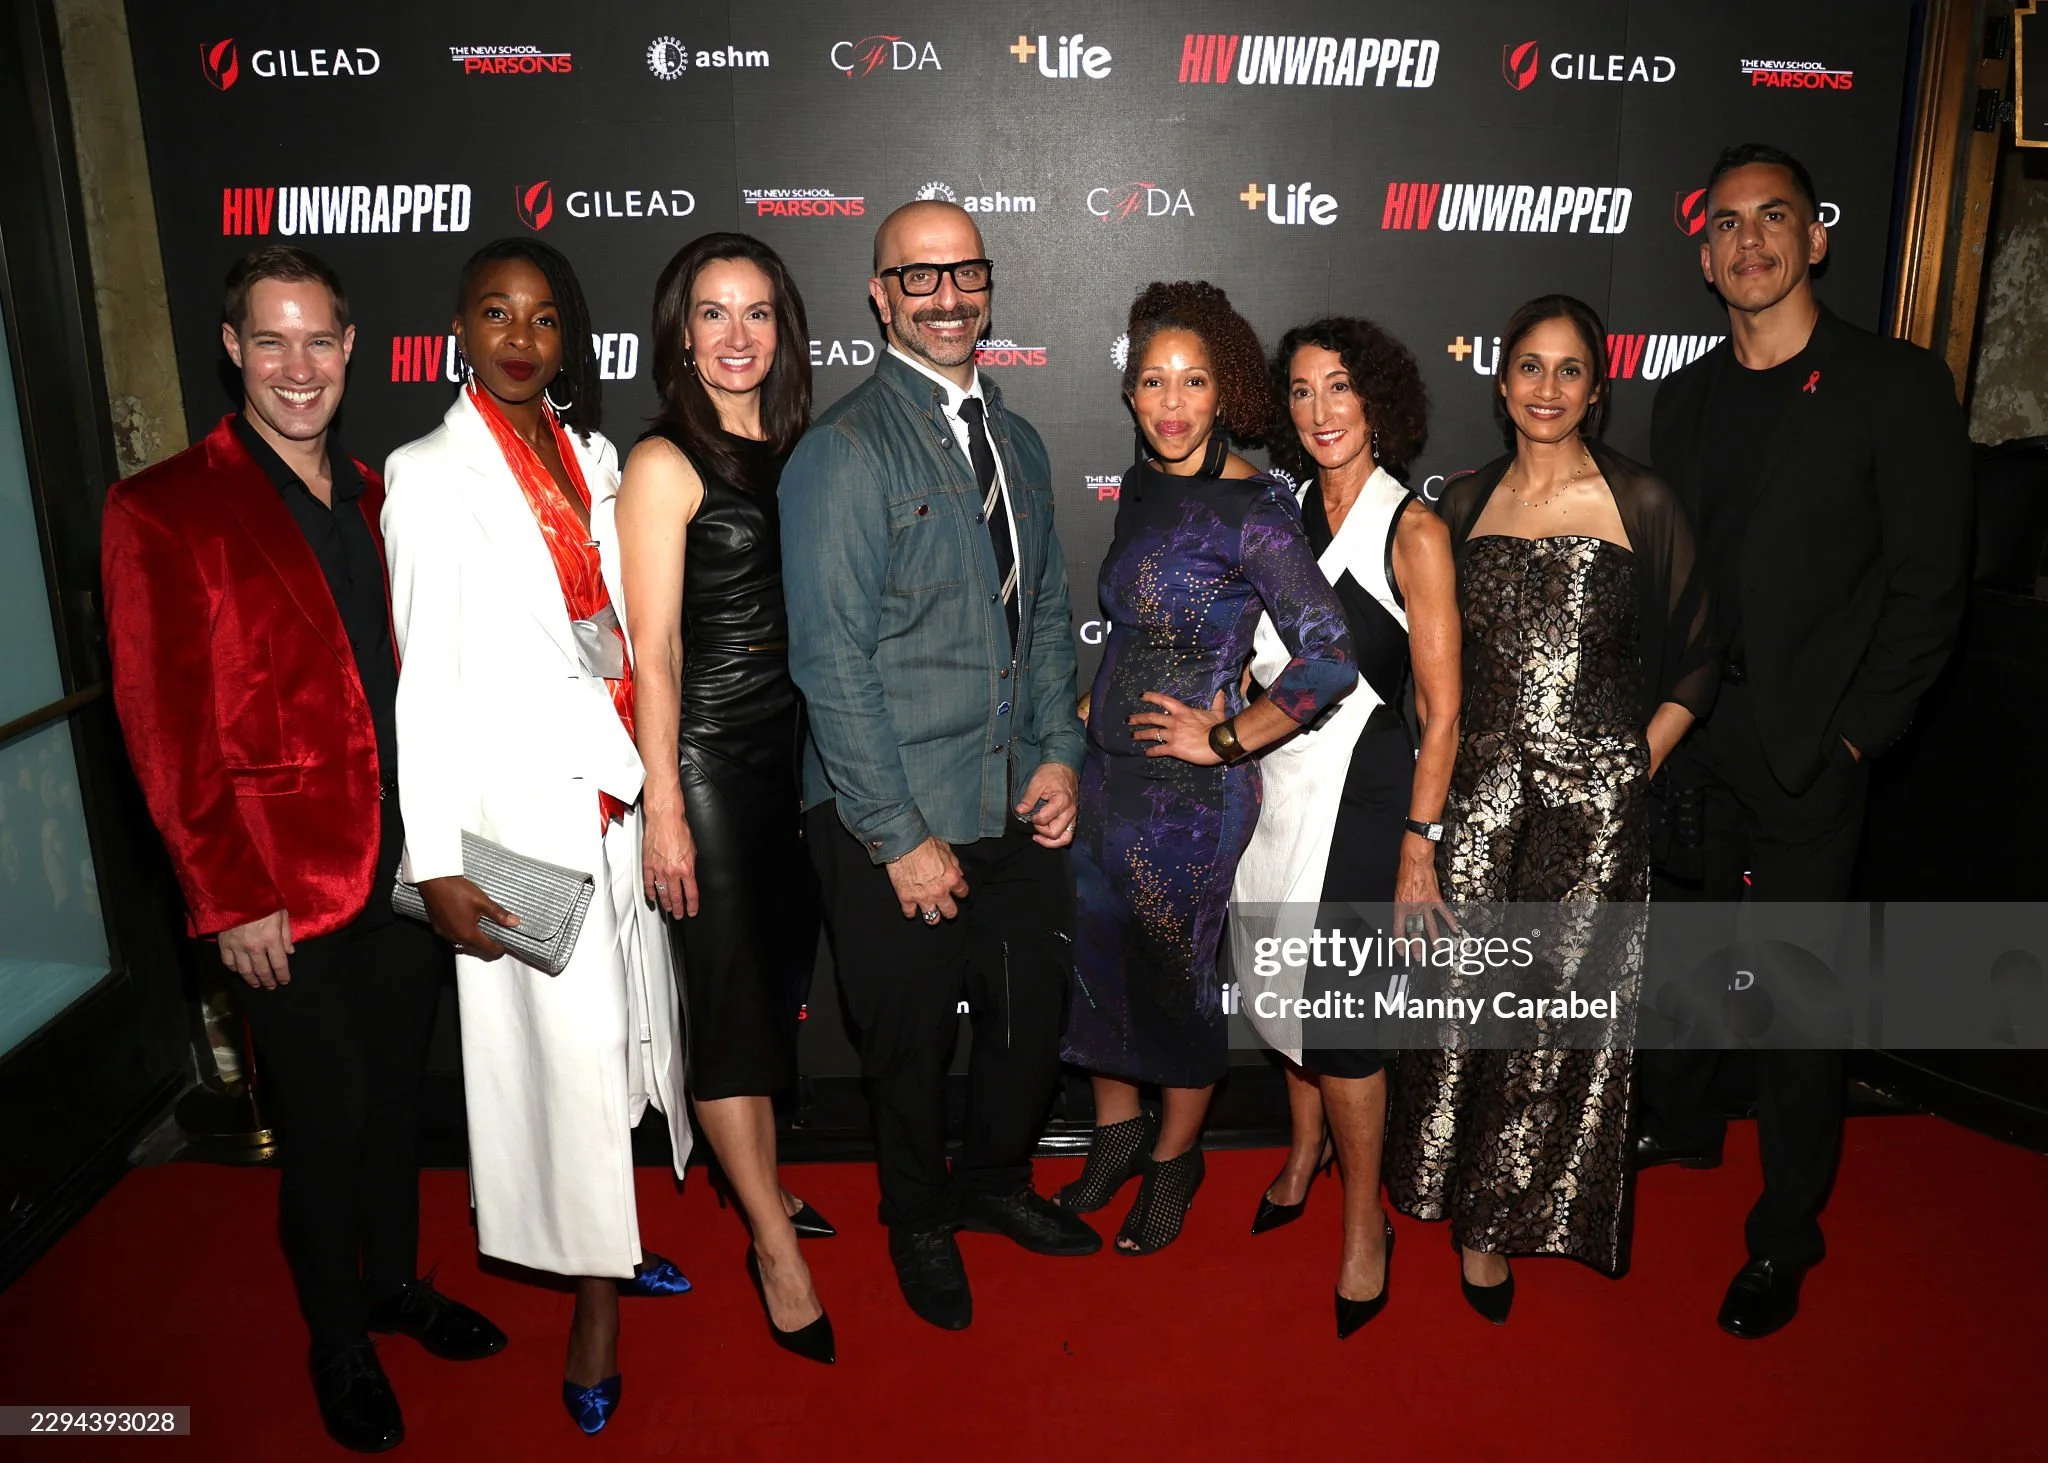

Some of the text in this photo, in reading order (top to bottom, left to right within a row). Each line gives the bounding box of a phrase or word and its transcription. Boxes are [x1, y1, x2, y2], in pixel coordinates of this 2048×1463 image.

[449, 45, 541, 55] THE NEW SCHOOL
[695, 46, 770, 68] ashm
[251, 47, 380, 77] GILEAD
[464, 57, 572, 75] PARSONS
[1550, 53, 1676, 83] GILEAD
[1740, 60, 1827, 70] THE NEW SCHOOL
[1751, 70, 1853, 90] PARSONS
[743, 188, 834, 198] THE NEW SCHOOL
[963, 191, 1036, 213] ashm
[566, 190, 695, 217] GILEAD
[757, 200, 865, 217] PARSONS
[809, 340, 875, 366] EAD
[976, 339, 1017, 347] SCHOOL
[391, 336, 444, 382] HIV
[975, 349, 1048, 366] RSONS
[1447, 335, 1501, 376] +Li
[1085, 475, 1104, 483] THE
